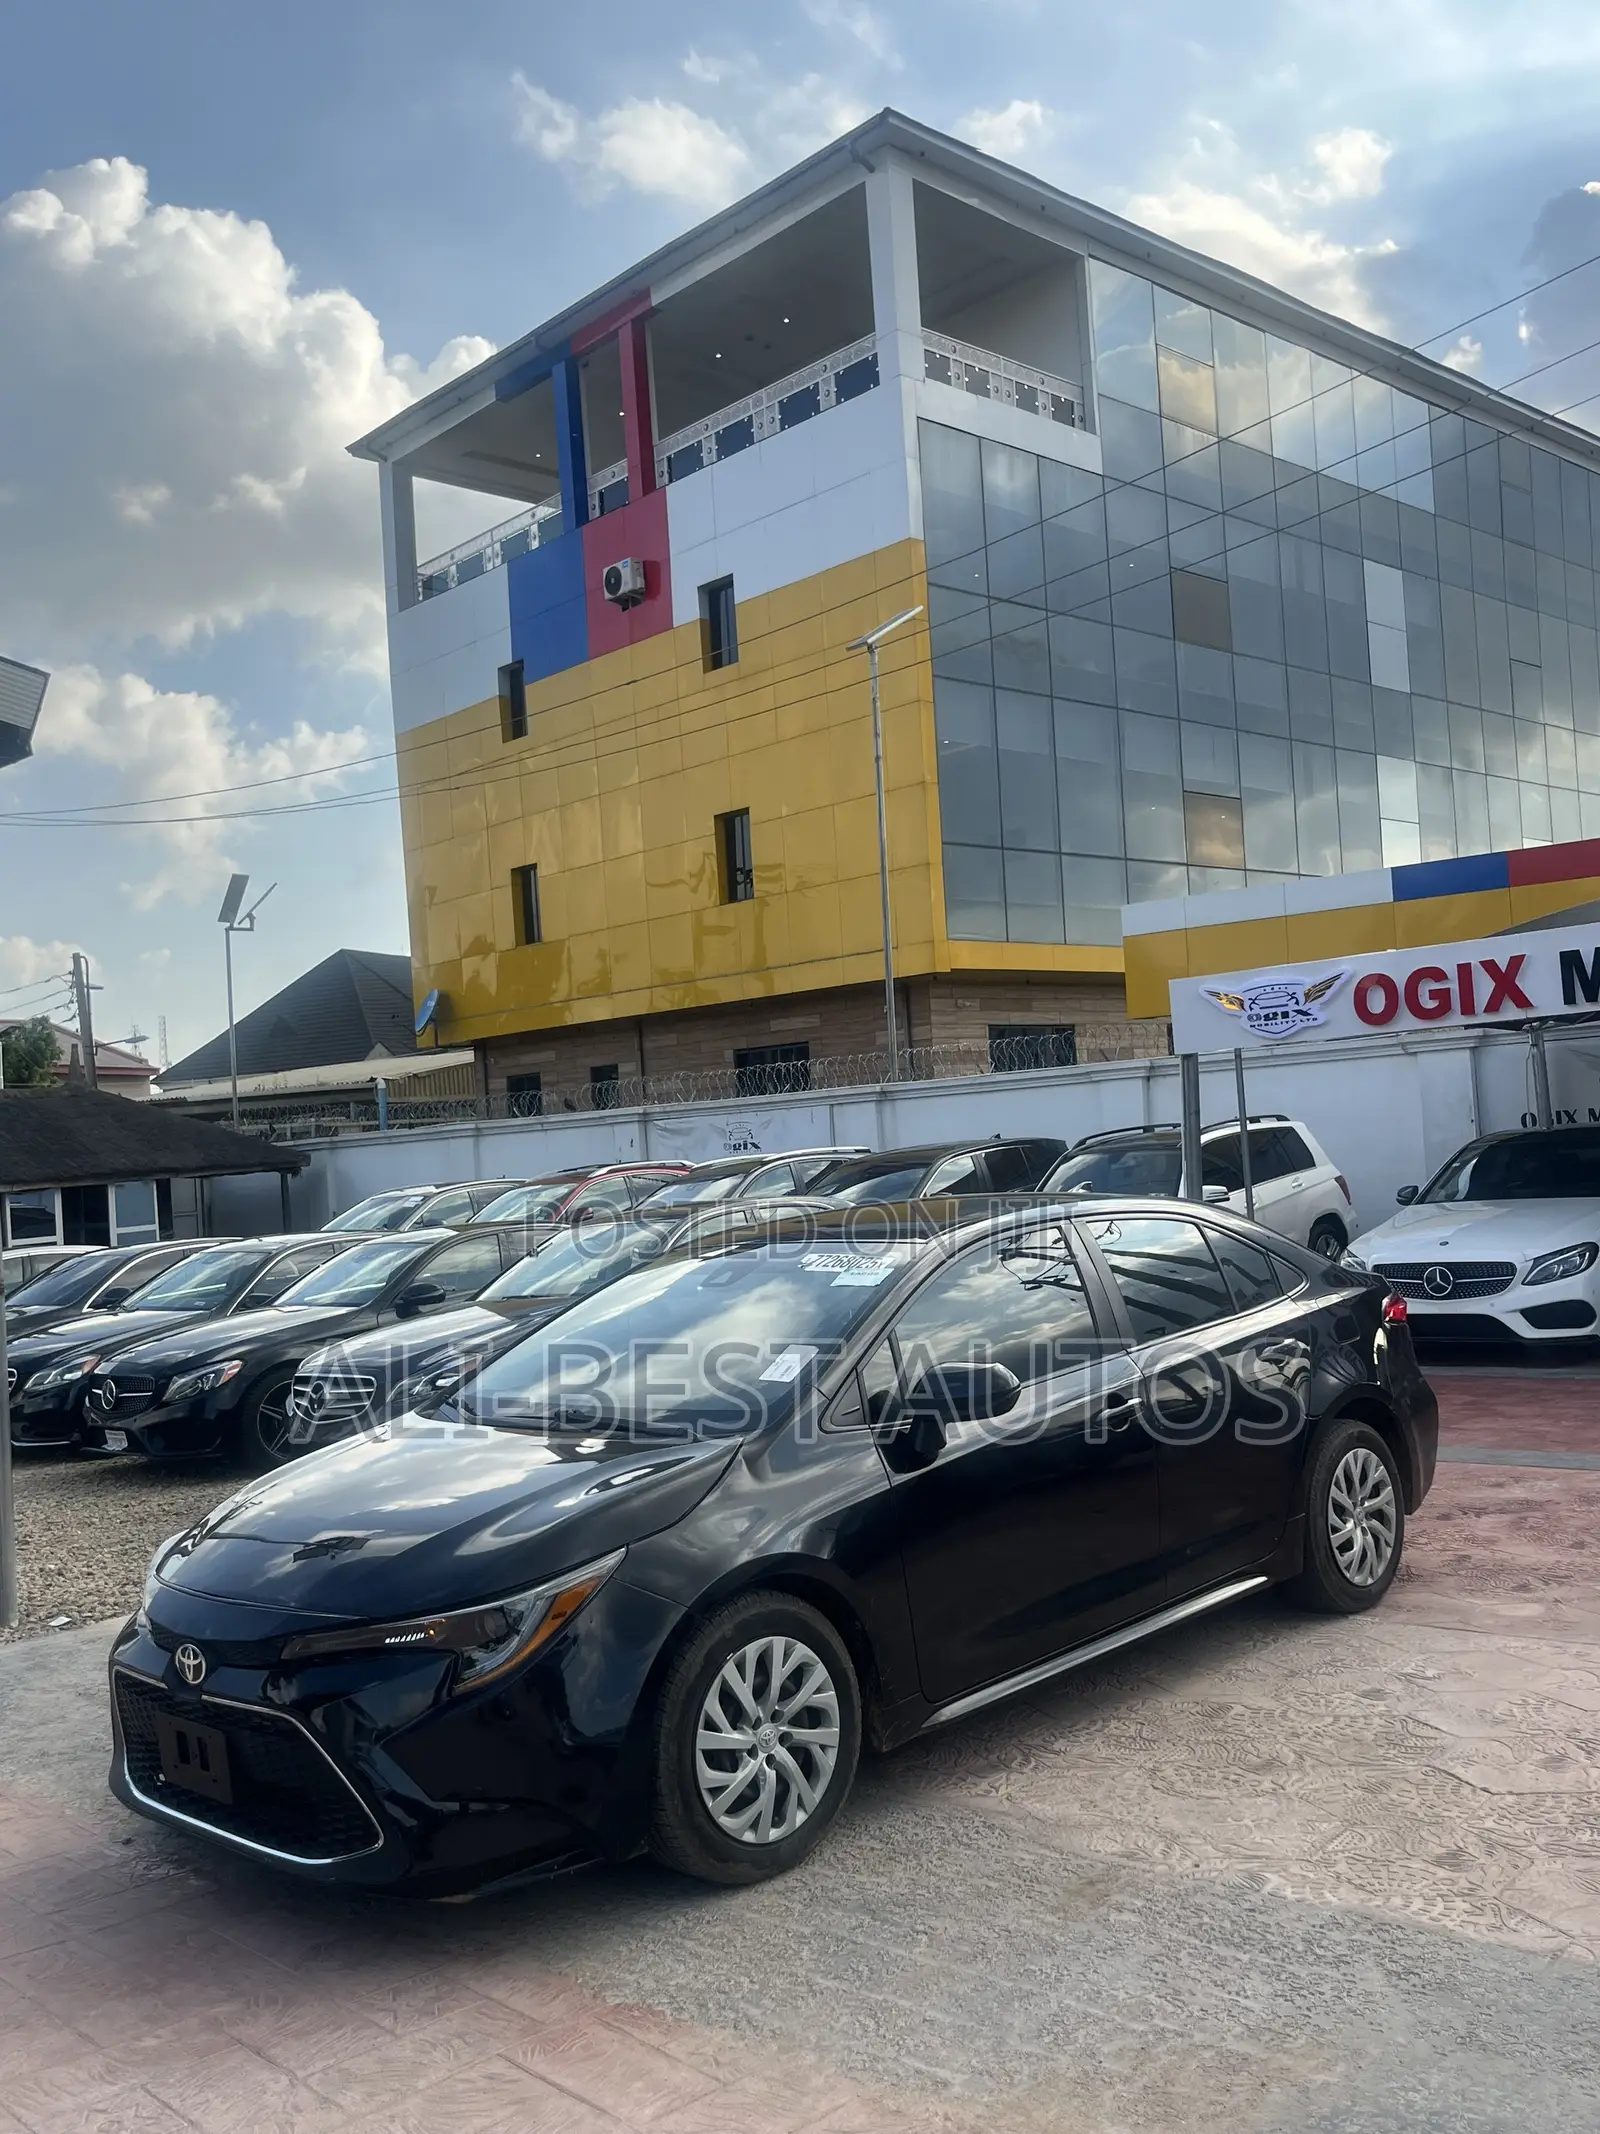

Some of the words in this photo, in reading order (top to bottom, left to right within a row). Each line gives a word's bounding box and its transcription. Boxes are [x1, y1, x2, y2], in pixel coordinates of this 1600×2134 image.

[1353, 953, 1535, 1026] OGIX
[1249, 1019, 1296, 1028] MOBILITY
[1520, 1109, 1577, 1128] OIX
